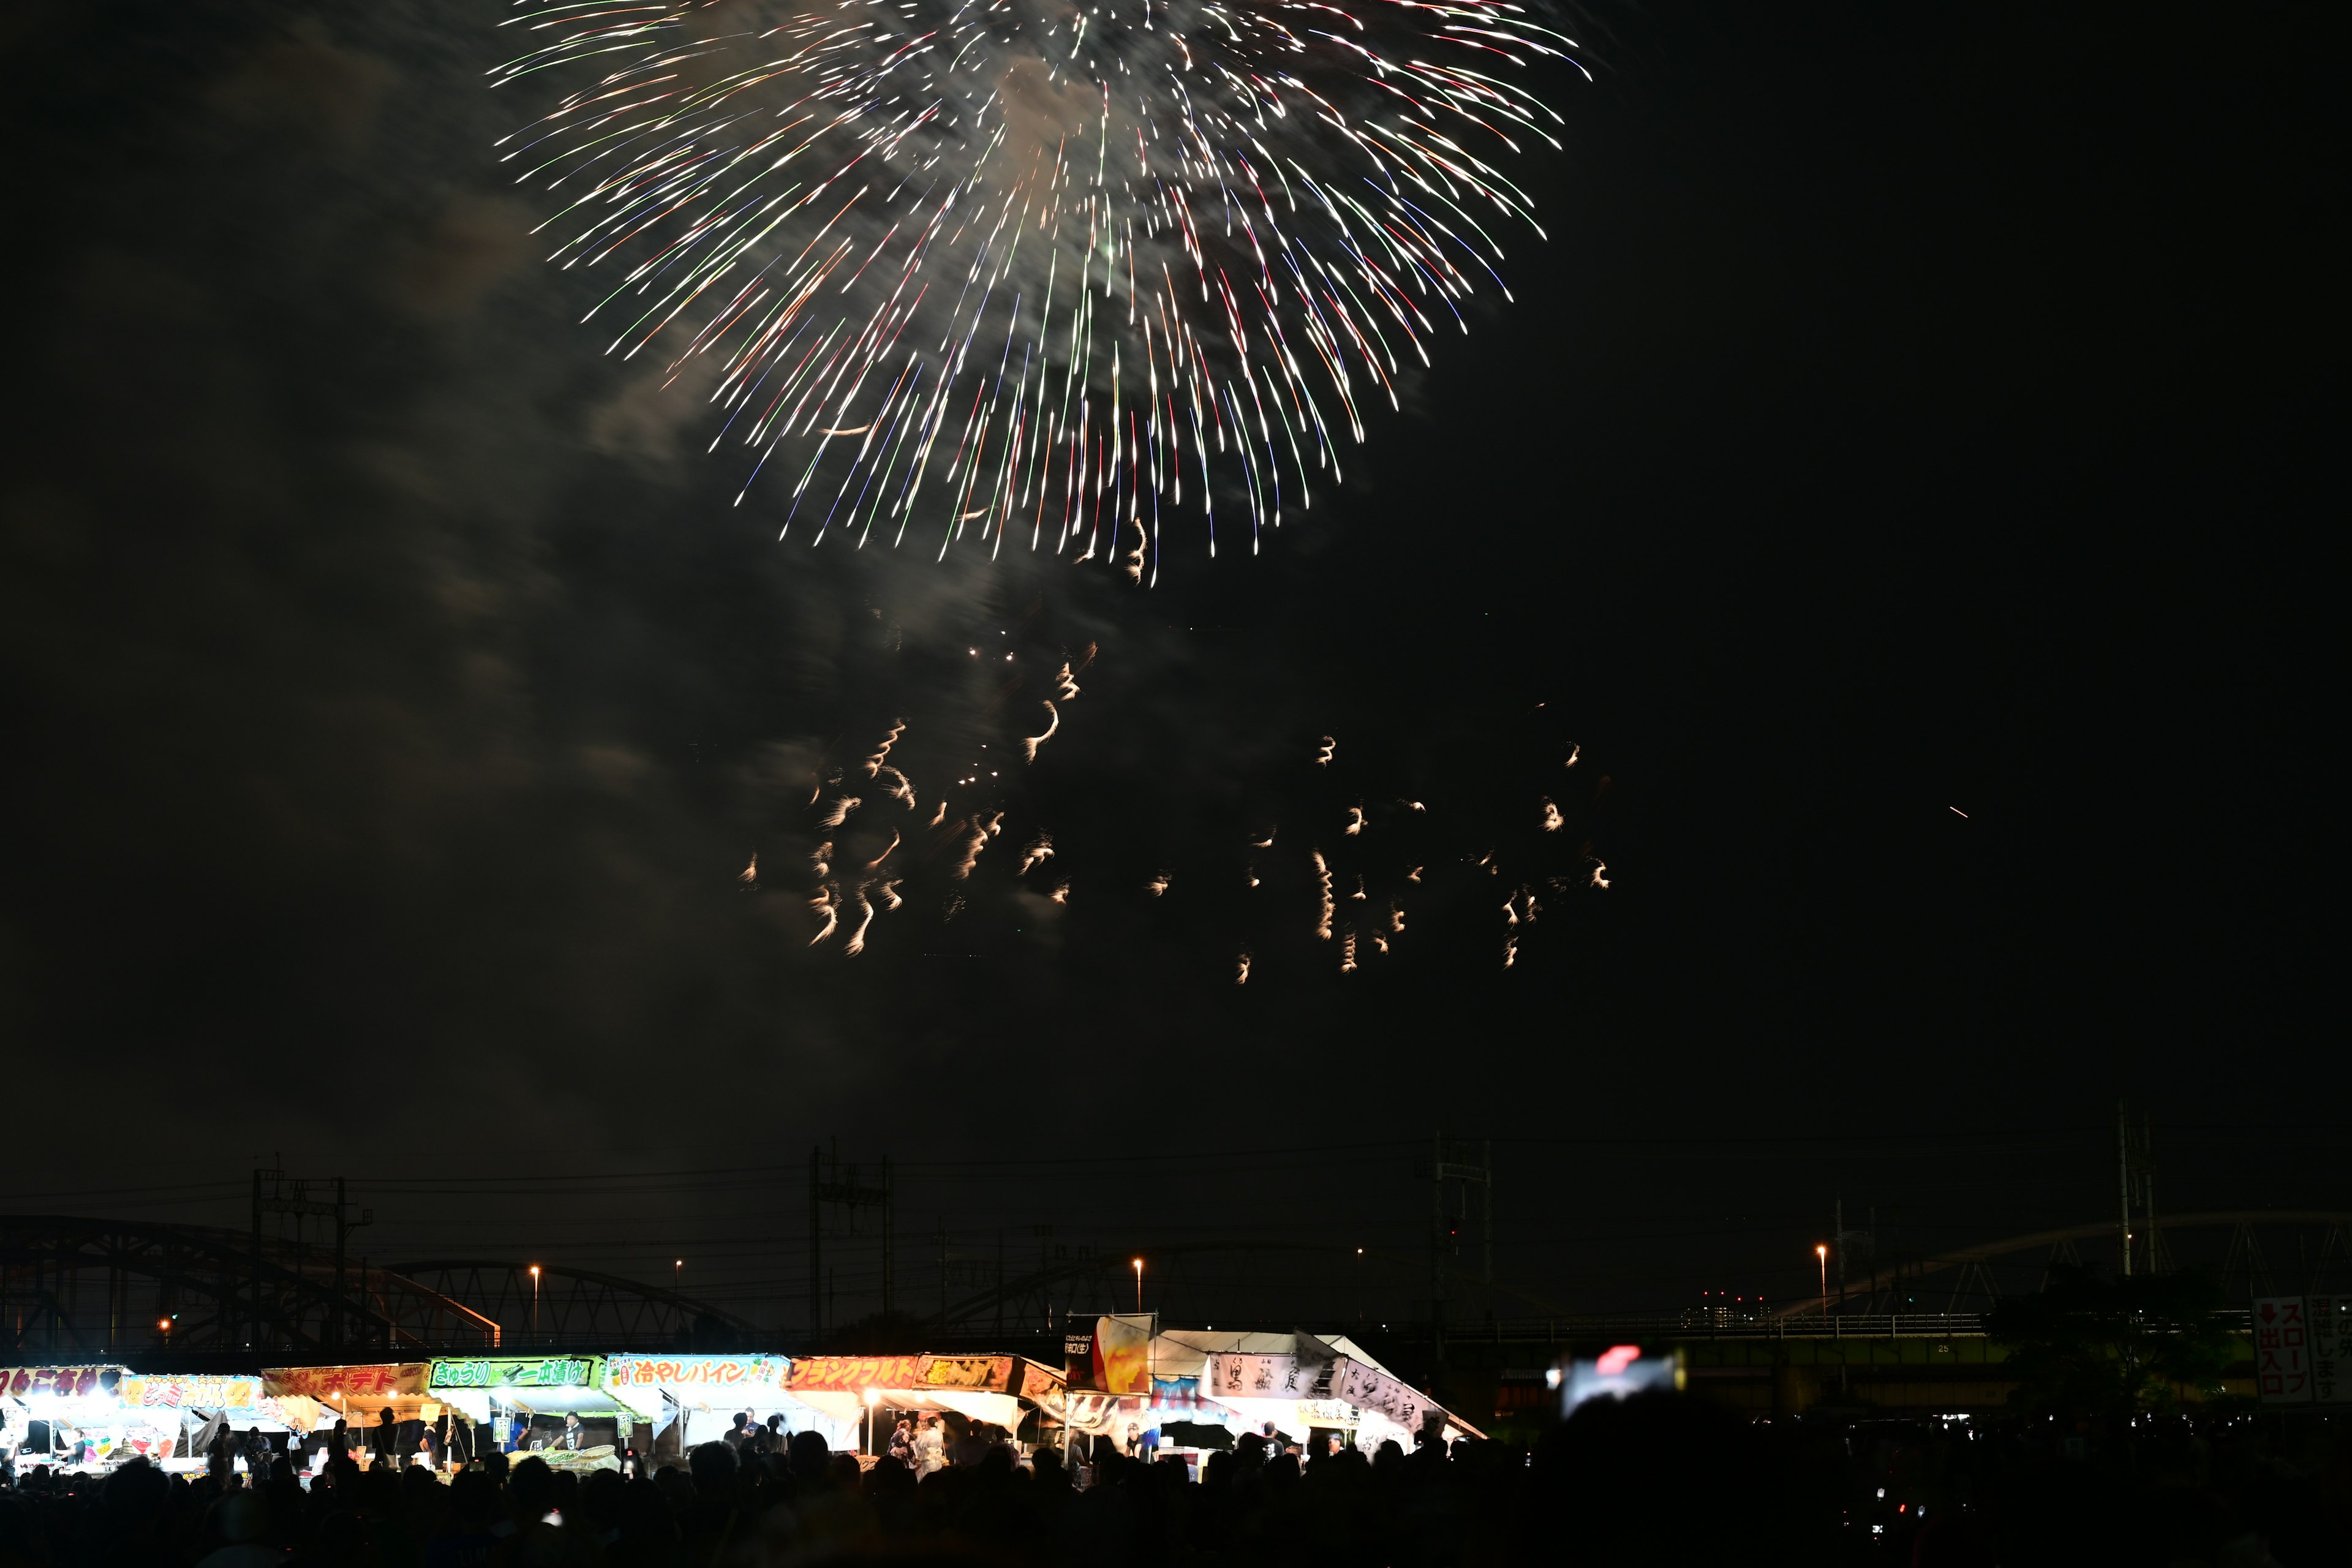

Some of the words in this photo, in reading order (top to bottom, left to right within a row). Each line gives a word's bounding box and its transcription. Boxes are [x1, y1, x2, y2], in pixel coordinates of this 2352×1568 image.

[2282, 1305, 2307, 1393] スロープ
[2312, 1298, 2336, 1398] 混雑します
[434, 1361, 491, 1386] きゅうり
[518, 1360, 585, 1385] 一本漬け
[634, 1360, 747, 1384] 冷やしパイン
[791, 1359, 914, 1385] フランクフルト
[2259, 1328, 2283, 1395] 出入口
[319, 1371, 397, 1393] ポテト
